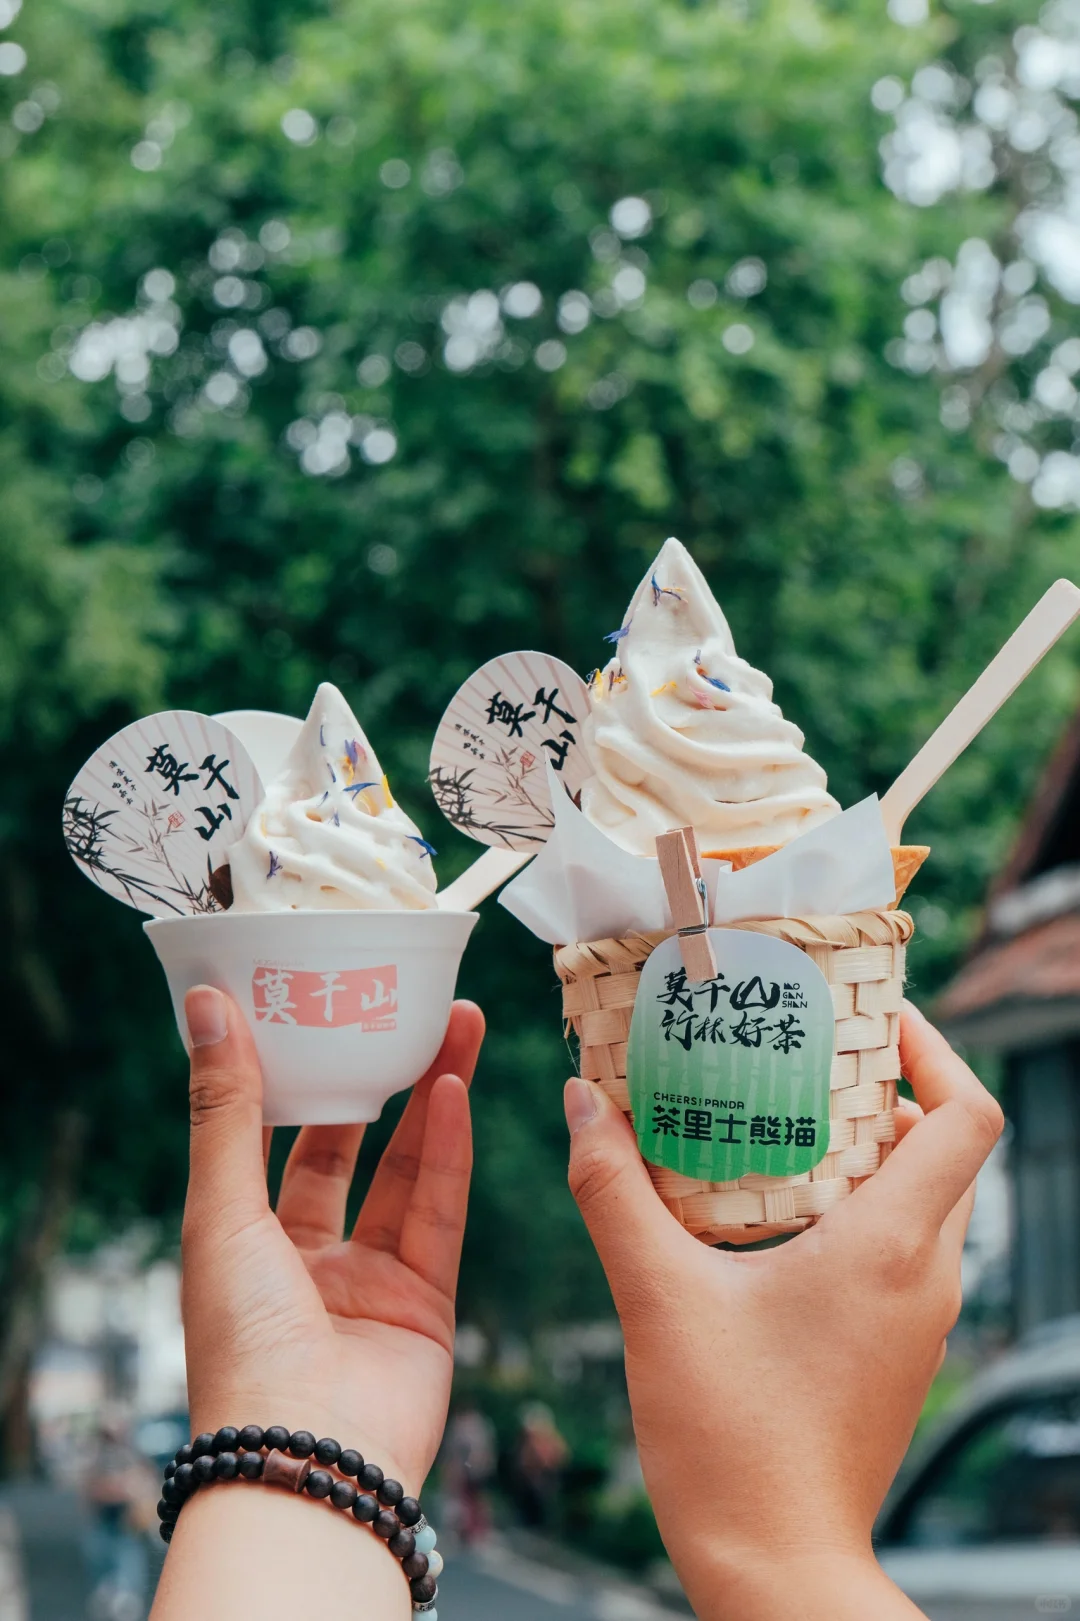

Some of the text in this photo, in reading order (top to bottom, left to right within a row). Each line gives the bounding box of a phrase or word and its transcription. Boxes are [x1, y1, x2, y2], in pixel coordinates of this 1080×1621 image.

[144, 743, 240, 841] 莫干山
[252, 968, 398, 1026] 莫干山
[656, 966, 781, 1013] 莫干山
[781, 1000, 808, 1009] SHAN
[782, 991, 804, 1000] GAN
[783, 982, 801, 991] MO
[659, 1010, 806, 1055] 竹林好茶
[651, 1104, 817, 1148] 茶里士熊猫
[704, 1098, 745, 1110] PANDA
